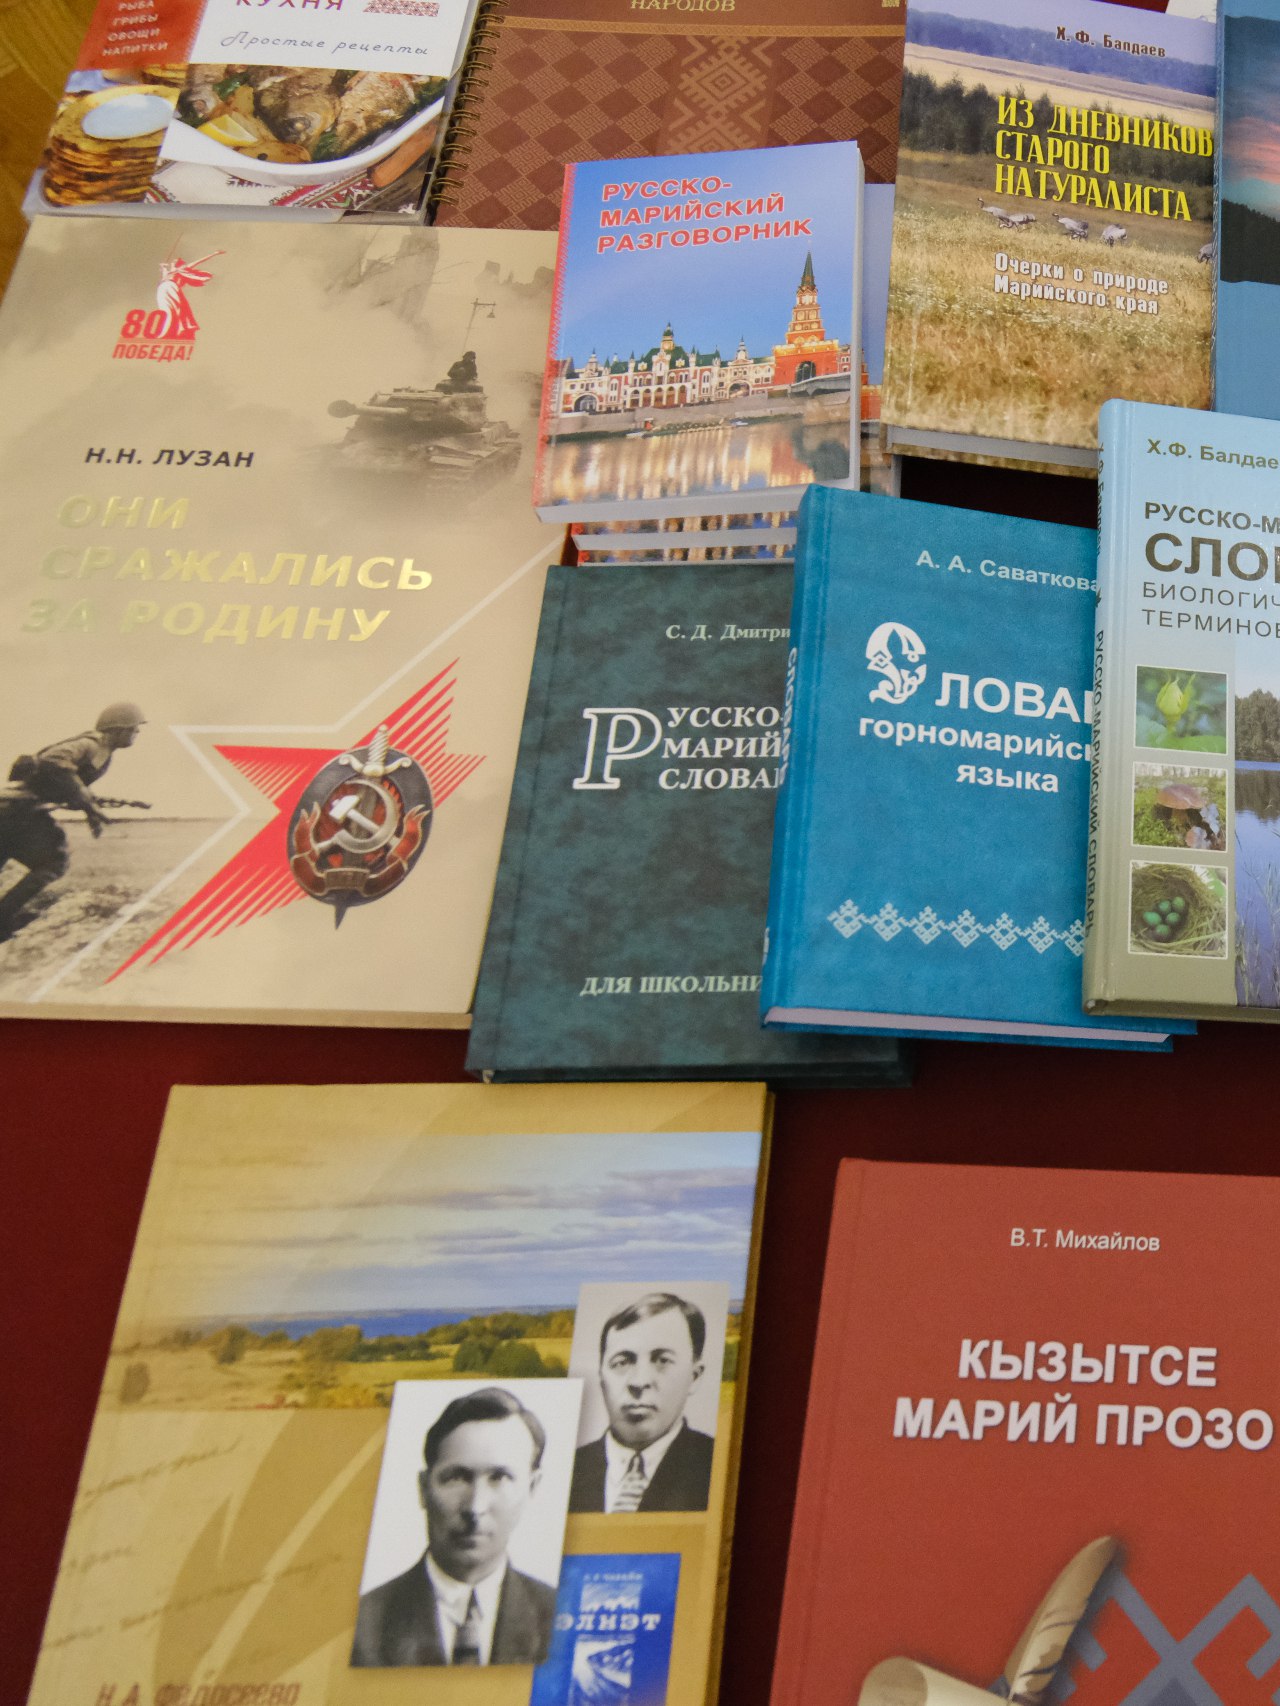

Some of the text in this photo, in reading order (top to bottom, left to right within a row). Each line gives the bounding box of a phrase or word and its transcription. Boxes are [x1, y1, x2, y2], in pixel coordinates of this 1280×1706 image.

[107, 28, 160, 41] ОВОЩИ
[112, 14, 158, 26] ГРИБЫ
[101, 42, 168, 56] НАПИТКИ
[220, 31, 429, 54] Простые рецепты
[1103, 34, 1166, 58] Балдаев
[997, 95, 1214, 157] ИЗ ДНЕВНИКОВ
[995, 130, 1110, 174] СТАРОГО
[602, 176, 732, 201] РУССКО-
[995, 163, 1192, 222] НАТУРАЛИСТА
[600, 192, 784, 228] МАРИЙСКИЙ
[597, 218, 813, 254] РАЗГОВОРНИК
[995, 252, 1168, 295] Очерки о природе
[994, 274, 1158, 315] Марийского края
[121, 309, 167, 339] 80
[112, 343, 194, 363] ПОБЕДА!
[85, 447, 254, 468] Н.Н. ЛУЗАН
[56, 494, 190, 529] ОНИ
[38, 545, 433, 591] СРАЖАЛИСЬ
[916, 550, 1097, 591] А. А. Саваткова
[21, 598, 391, 645] ЗА РОДИНУ
[665, 624, 686, 639] С.
[690, 624, 712, 641] Д.
[956, 764, 1059, 793] языка
[580, 977, 632, 996] ДЛЯ
[1010, 1228, 1160, 1252] В.Т. Михайлов
[957, 1339, 1218, 1388] КЫЗЫТСЕ
[892, 1392, 1274, 1452] МАРИЙ ПРОЗО
